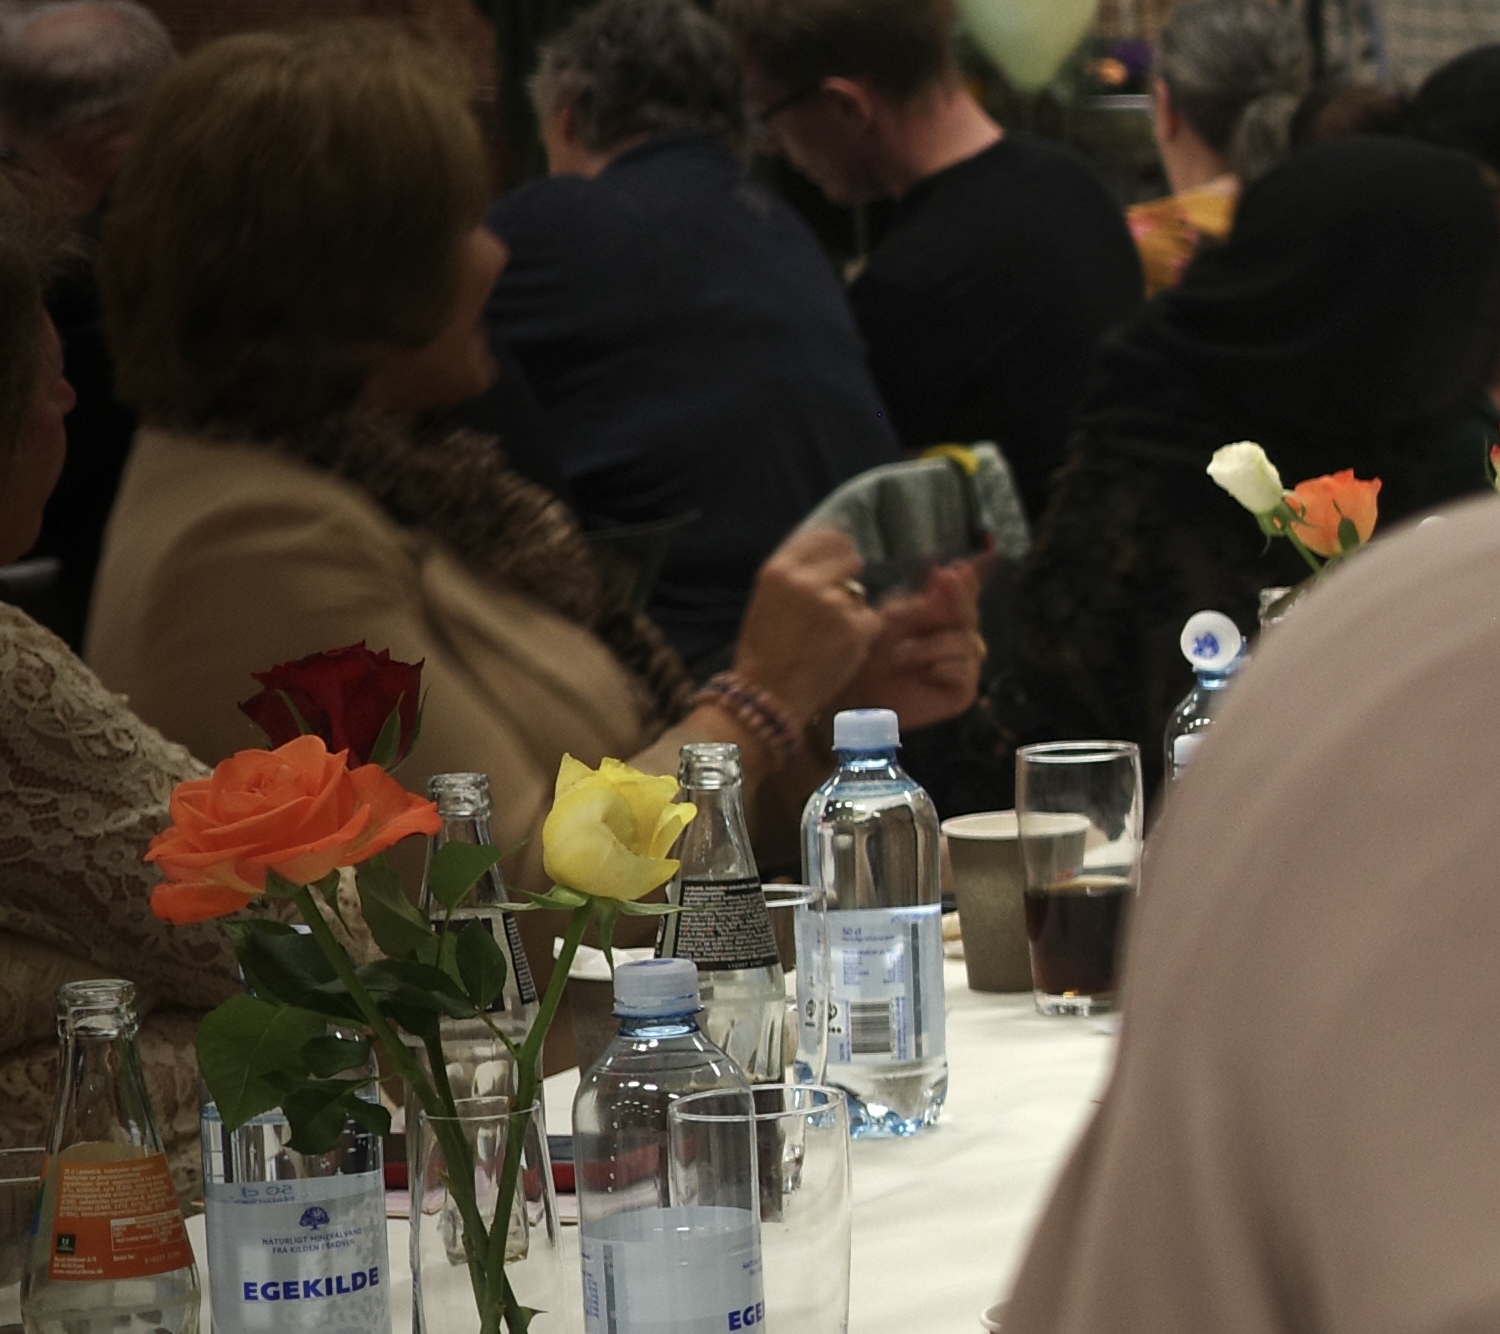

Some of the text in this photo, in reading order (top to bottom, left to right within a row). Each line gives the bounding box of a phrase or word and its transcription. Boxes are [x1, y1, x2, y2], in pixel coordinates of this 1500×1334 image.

[262, 1236, 308, 1246] NATURLIGT
[272, 1246, 287, 1254] FRA
[290, 1244, 320, 1254] KILDEN
[243, 1266, 380, 1301] EGEKILDE
